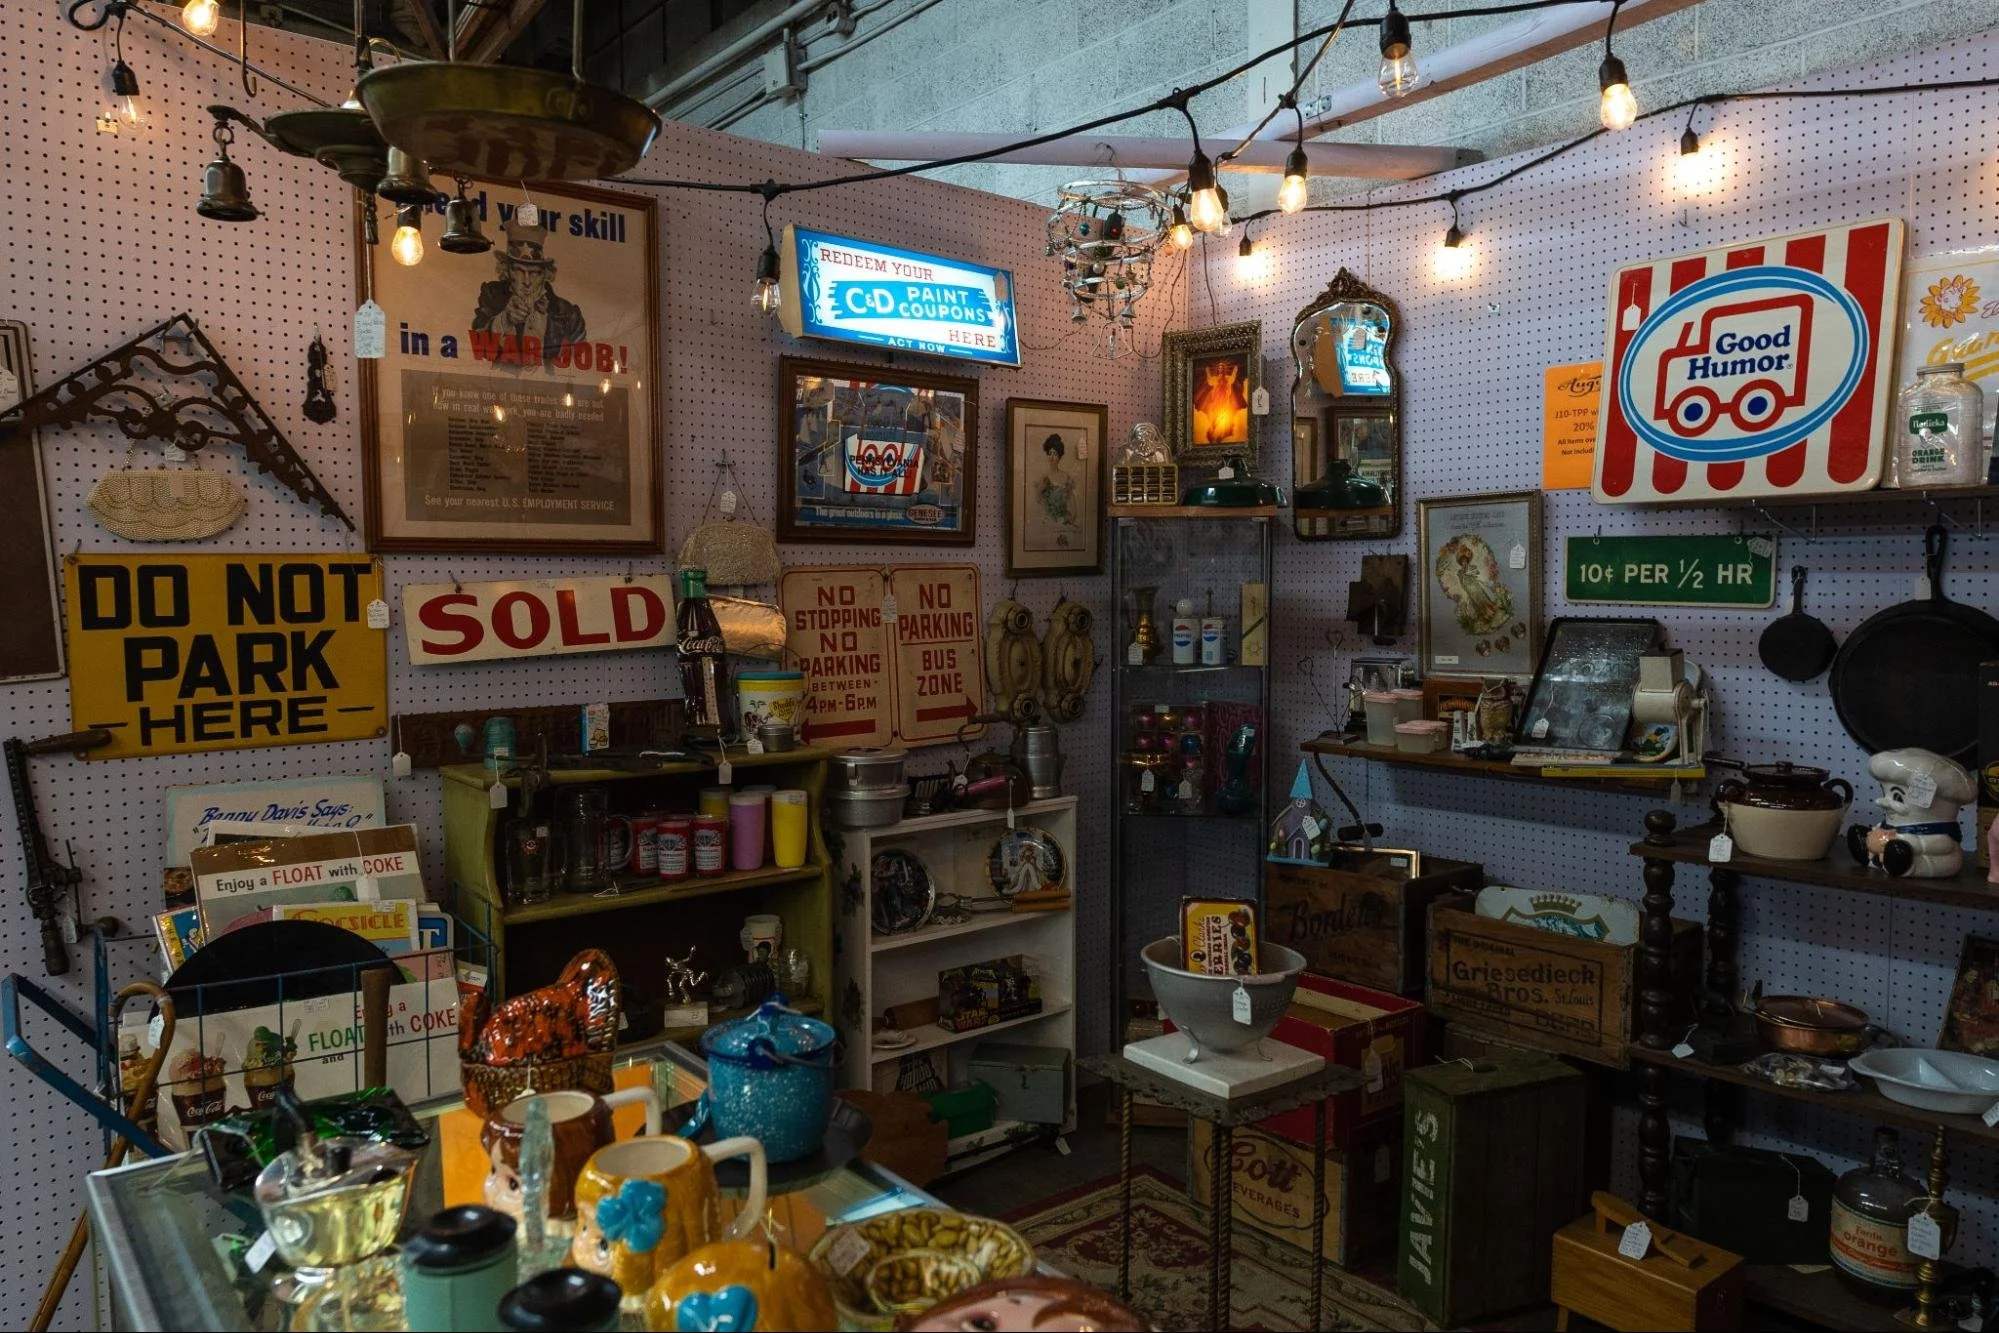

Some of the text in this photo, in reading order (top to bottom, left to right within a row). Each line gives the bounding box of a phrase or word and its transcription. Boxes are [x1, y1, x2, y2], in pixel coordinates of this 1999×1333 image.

[497, 202, 561, 235] yur
[569, 209, 625, 243] skill
[820, 248, 935, 281] REDEEM YOUR
[845, 286, 968, 314] C&D PAINT
[899, 304, 986, 323] COUPONS
[400, 322, 430, 356] in
[440, 335, 458, 360] a
[468, 329, 542, 367] WAR
[552, 341, 628, 374] JOB!
[888, 337, 945, 353] ACT NOW
[947, 329, 996, 348] HERE
[1716, 324, 1791, 355] Good
[1687, 353, 1790, 380] Humor
[425, 495, 441, 506] See
[444, 497, 462, 508] your
[523, 498, 578, 510] EMPLOYMENT
[581, 500, 614, 511] SERVICE
[1580, 564, 1614, 583] 10¢
[1624, 564, 1669, 584] PER
[1717, 563, 1753, 585] HR
[78, 562, 372, 631] DO NOT
[817, 585, 856, 606] NO
[919, 584, 951, 609] NO
[418, 586, 667, 656] SOLD
[795, 608, 881, 631] STOPPING
[899, 612, 973, 641] PARKING
[820, 631, 857, 653] NO
[123, 629, 341, 703] PARK
[801, 653, 880, 678] PARKING
[922, 649, 956, 671] BUS
[812, 679, 871, 692] BETWEEN
[917, 673, 963, 696] ZONE
[139, 695, 329, 747] HERE
[261, 800, 309, 821] Davis
[310, 799, 354, 821] Says:
[216, 856, 404, 893] Enjoy a FLOAT with COKE
[1211, 916, 1223, 975] ERRIES
[1453, 960, 1596, 985] Griesedieck
[1485, 982, 1549, 1004] Bros.
[399, 1002, 406, 1011] a
[308, 1024, 365, 1052] FLOAT
[410, 1008, 457, 1033] COKE
[322, 1052, 345, 1065] and
[1232, 1181, 1300, 1219] EVERAGES
[1408, 1109, 1439, 1286] JAVIE'S
[1844, 1231, 1897, 1257] orange
